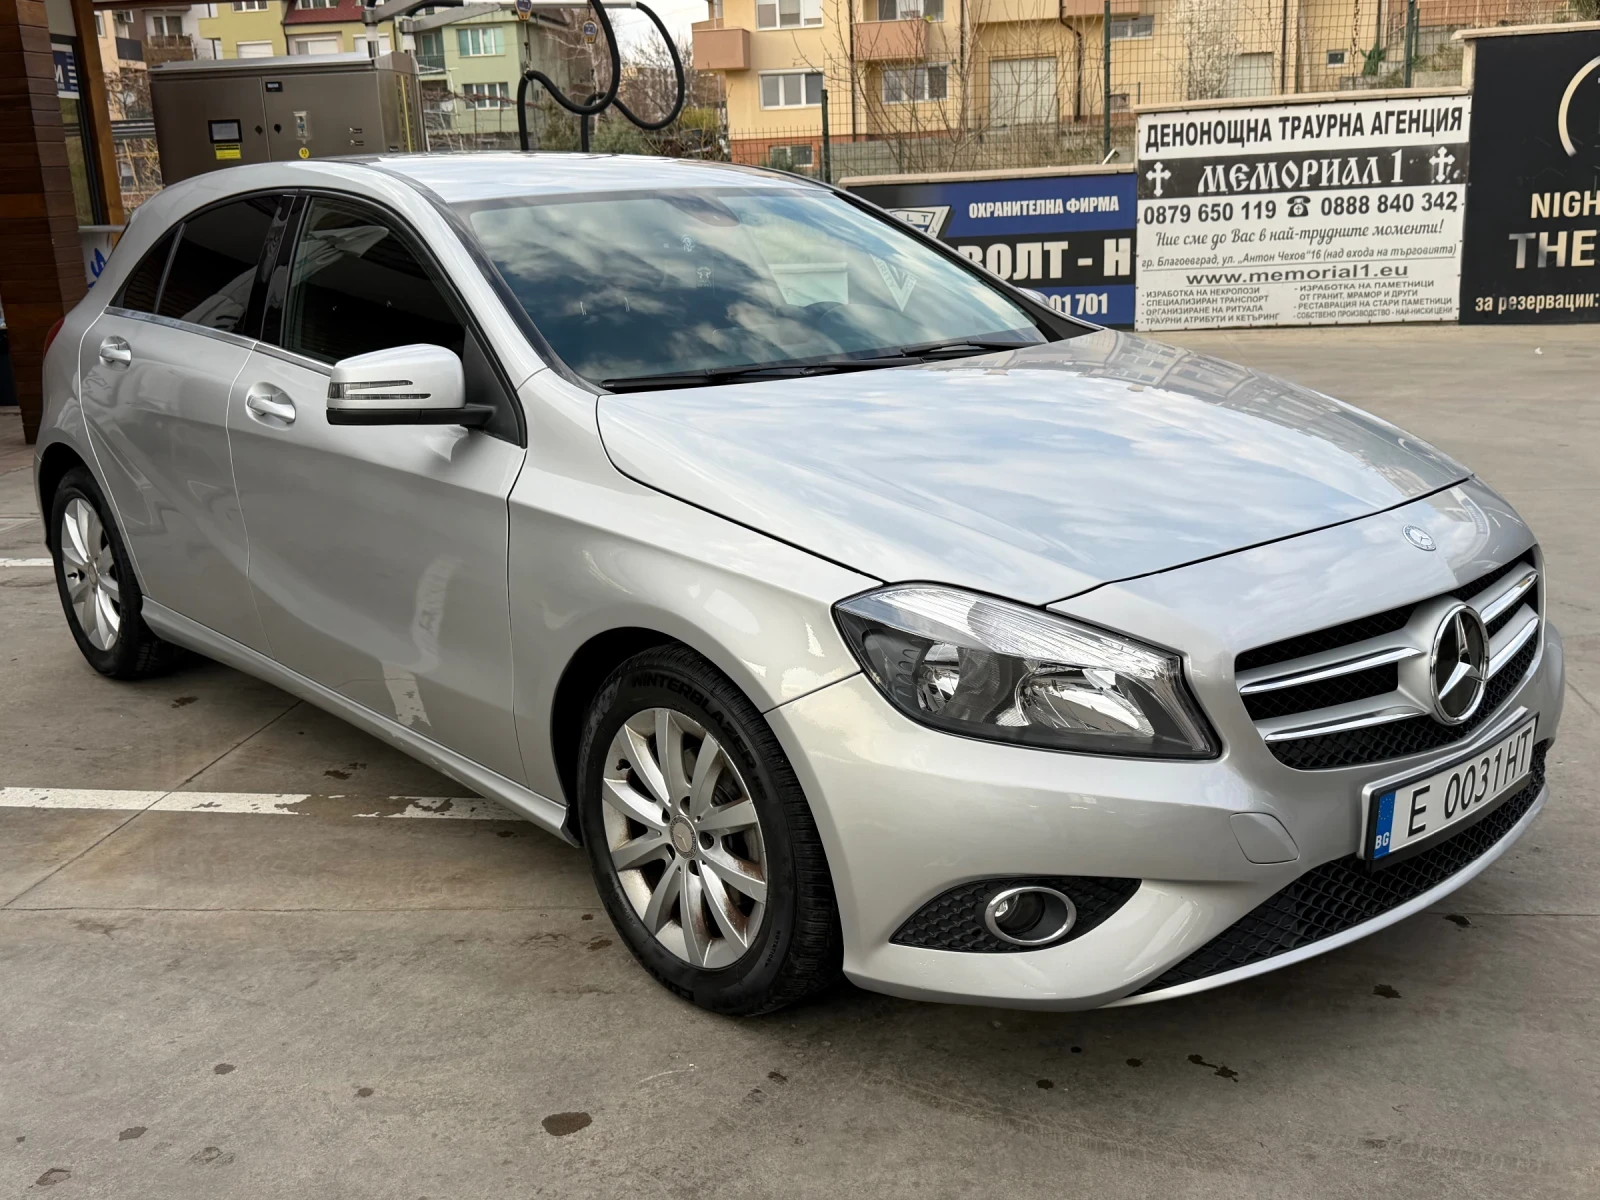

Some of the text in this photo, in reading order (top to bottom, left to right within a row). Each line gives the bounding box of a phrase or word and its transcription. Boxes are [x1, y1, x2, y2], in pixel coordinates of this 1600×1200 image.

[1146, 107, 1462, 153] ДЕНОНОЩНА ТРАУРНА АГЕНЦИЯ
[1197, 149, 1404, 194] МЕМОРИАЛ 1
[968, 196, 1119, 219] ОХРАНИТЕЛНА ФИРМА
[1144, 200, 1276, 225] 0879 650 119
[1320, 191, 1458, 216] 0888 840 342
[1530, 190, 1600, 219] NIGH
[1156, 218, 1444, 250] Ние сме до Вас в най-трудните моменти!
[1104, 238, 1132, 277] Н
[1142, 259, 1155, 269] гр.
[1158, 254, 1220, 268] Благоевград,
[1222, 255, 1236, 267] ул.
[1323, 248, 1345, 262] (над
[1346, 246, 1374, 258] входа
[1376, 248, 1388, 258] на
[1390, 243, 1457, 258] търговията)
[1508, 229, 1598, 269] THE
[1186, 264, 1408, 285] www.memorial1.eu
[1300, 282, 1356, 291] ИЗРАБОТКА
[1374, 280, 1434, 289] ПАМЕТНИЦИ
[1076, 292, 1108, 316] 701
[1146, 290, 1195, 298] ИЗРАБОТКА
[1210, 288, 1260, 296] НЕКРОЛОЗИ
[1146, 296, 1269, 307] СПЕЦИАЛИЗИРАН ТРАНСПОРТ
[1298, 301, 1357, 310] РЕСТАВРАЦИЯ
[1402, 298, 1452, 306] ПАМЕТНИЦИ
[1391, 289, 1418, 297] ДРУГИ
[1475, 292, 1600, 315] за резервации:
[1146, 307, 1210, 316] ОРГАНИЗИРАНЕ
[1225, 304, 1264, 313] РИТУАЛА
[1146, 318, 1182, 326] ТРАУРНИ
[1184, 315, 1227, 324] АТРИБУТИ
[1236, 312, 1280, 322] КЕТЪРИНГ
[1338, 309, 1390, 318] ПРОИЗВОДСТВО
[1434, 306, 1453, 315] ЦЕНИ
[1407, 784, 1430, 838] E
[1375, 832, 1390, 850] BG
